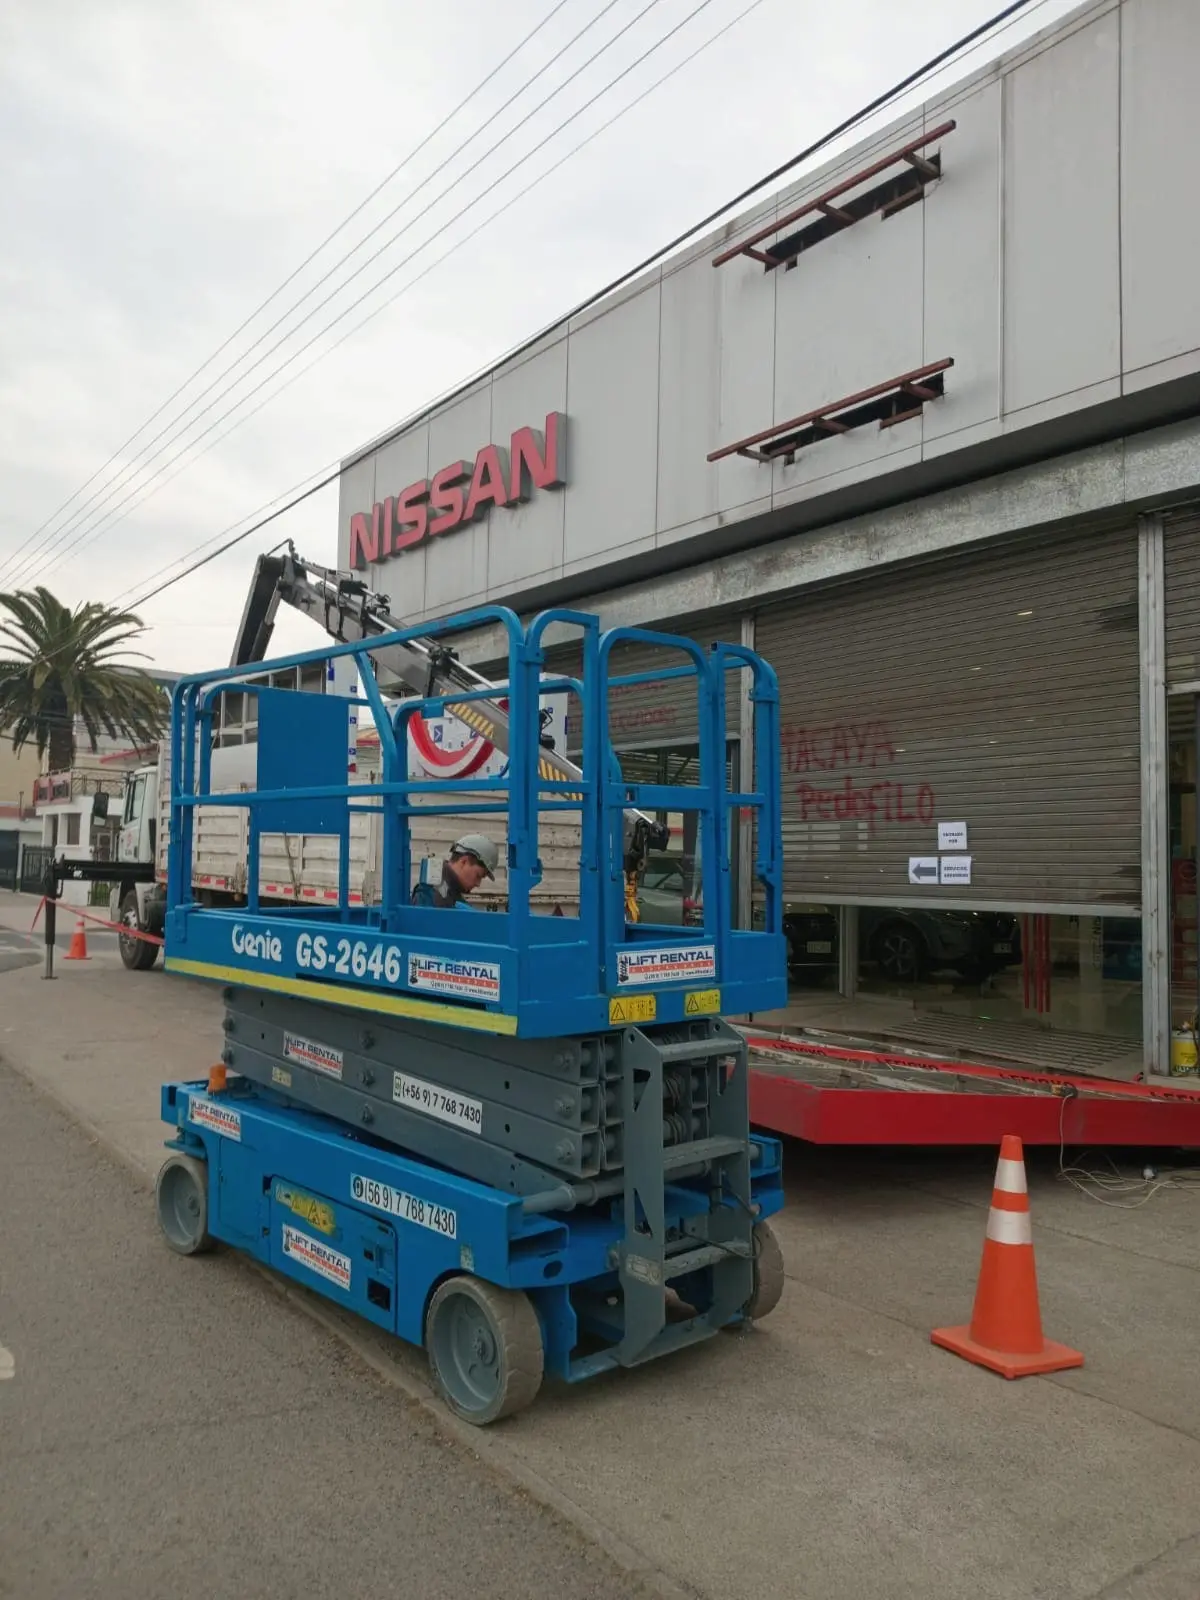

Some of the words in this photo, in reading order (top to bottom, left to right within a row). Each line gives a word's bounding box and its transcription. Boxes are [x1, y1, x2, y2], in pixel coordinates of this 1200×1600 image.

[349, 411, 565, 569] NISSAN
[231, 923, 282, 962] Genie
[296, 932, 401, 983] GS-2646
[628, 954, 657, 966] LIFT
[660, 950, 713, 964] RENTAL
[418, 959, 442, 972] LIFT
[444, 962, 498, 980] RENTAL
[291, 1039, 306, 1050] LIFT
[308, 1044, 341, 1063] RENTAL
[402, 1081, 420, 1101] (+56
[422, 1089, 431, 1107] 9)
[433, 1092, 438, 1108] 7
[441, 1096, 456, 1114] 768
[459, 1102, 480, 1124] 7430
[364, 1181, 380, 1206] (56
[382, 1186, 393, 1211] 9)
[396, 1191, 402, 1211] 7
[405, 1195, 425, 1223] 768
[428, 1203, 455, 1235] 7430
[290, 1234, 309, 1247] LIFT
[310, 1242, 350, 1272] RENTAL
